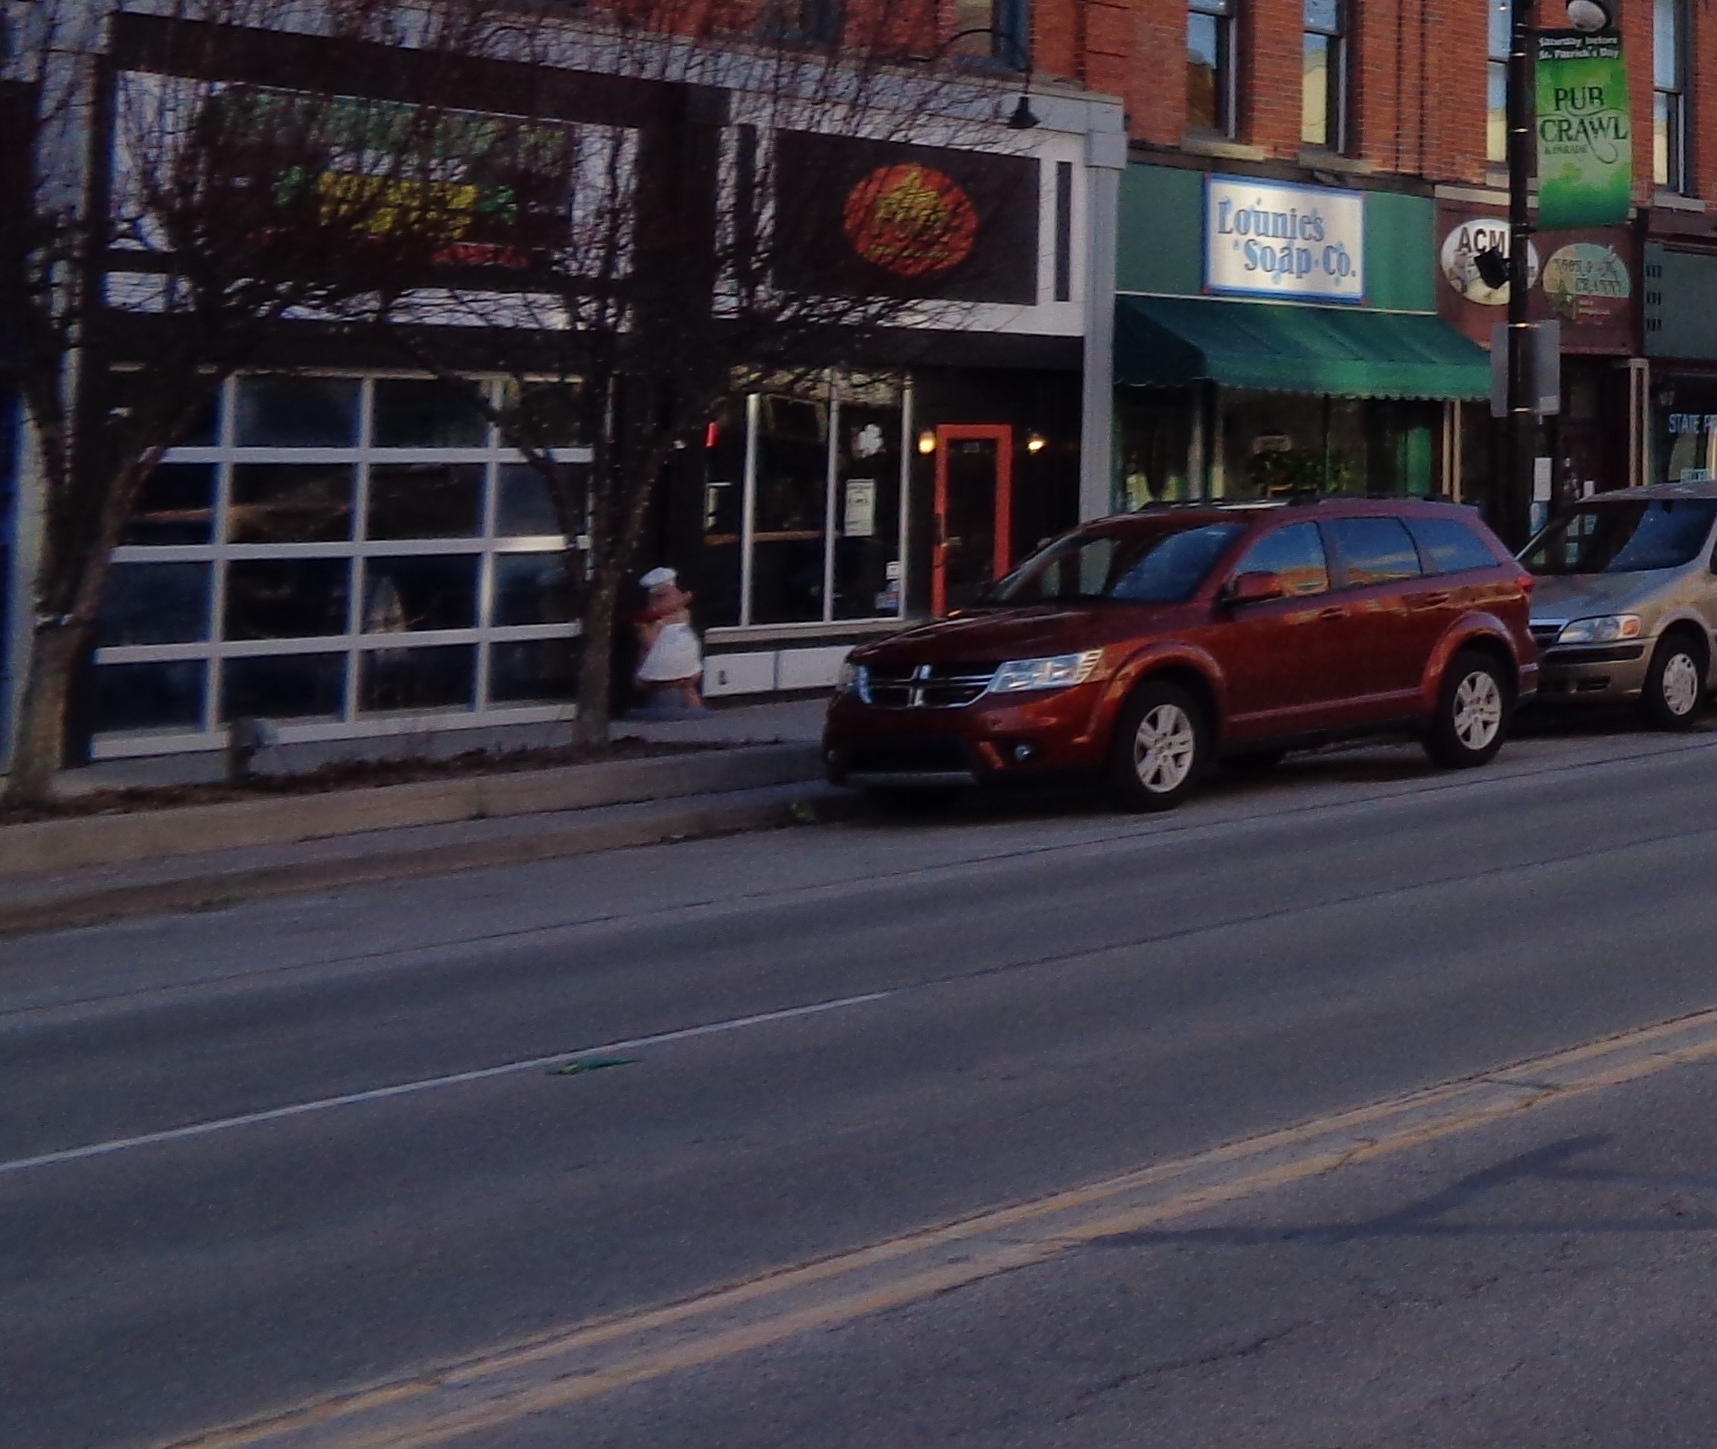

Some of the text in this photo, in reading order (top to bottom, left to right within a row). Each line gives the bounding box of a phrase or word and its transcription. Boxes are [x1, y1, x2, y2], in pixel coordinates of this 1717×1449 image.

[1553, 86, 1604, 111] PUB
[1540, 116, 1629, 145] CRAWL
[1458, 226, 1506, 254] ACM
[1244, 238, 1312, 279] Soap
